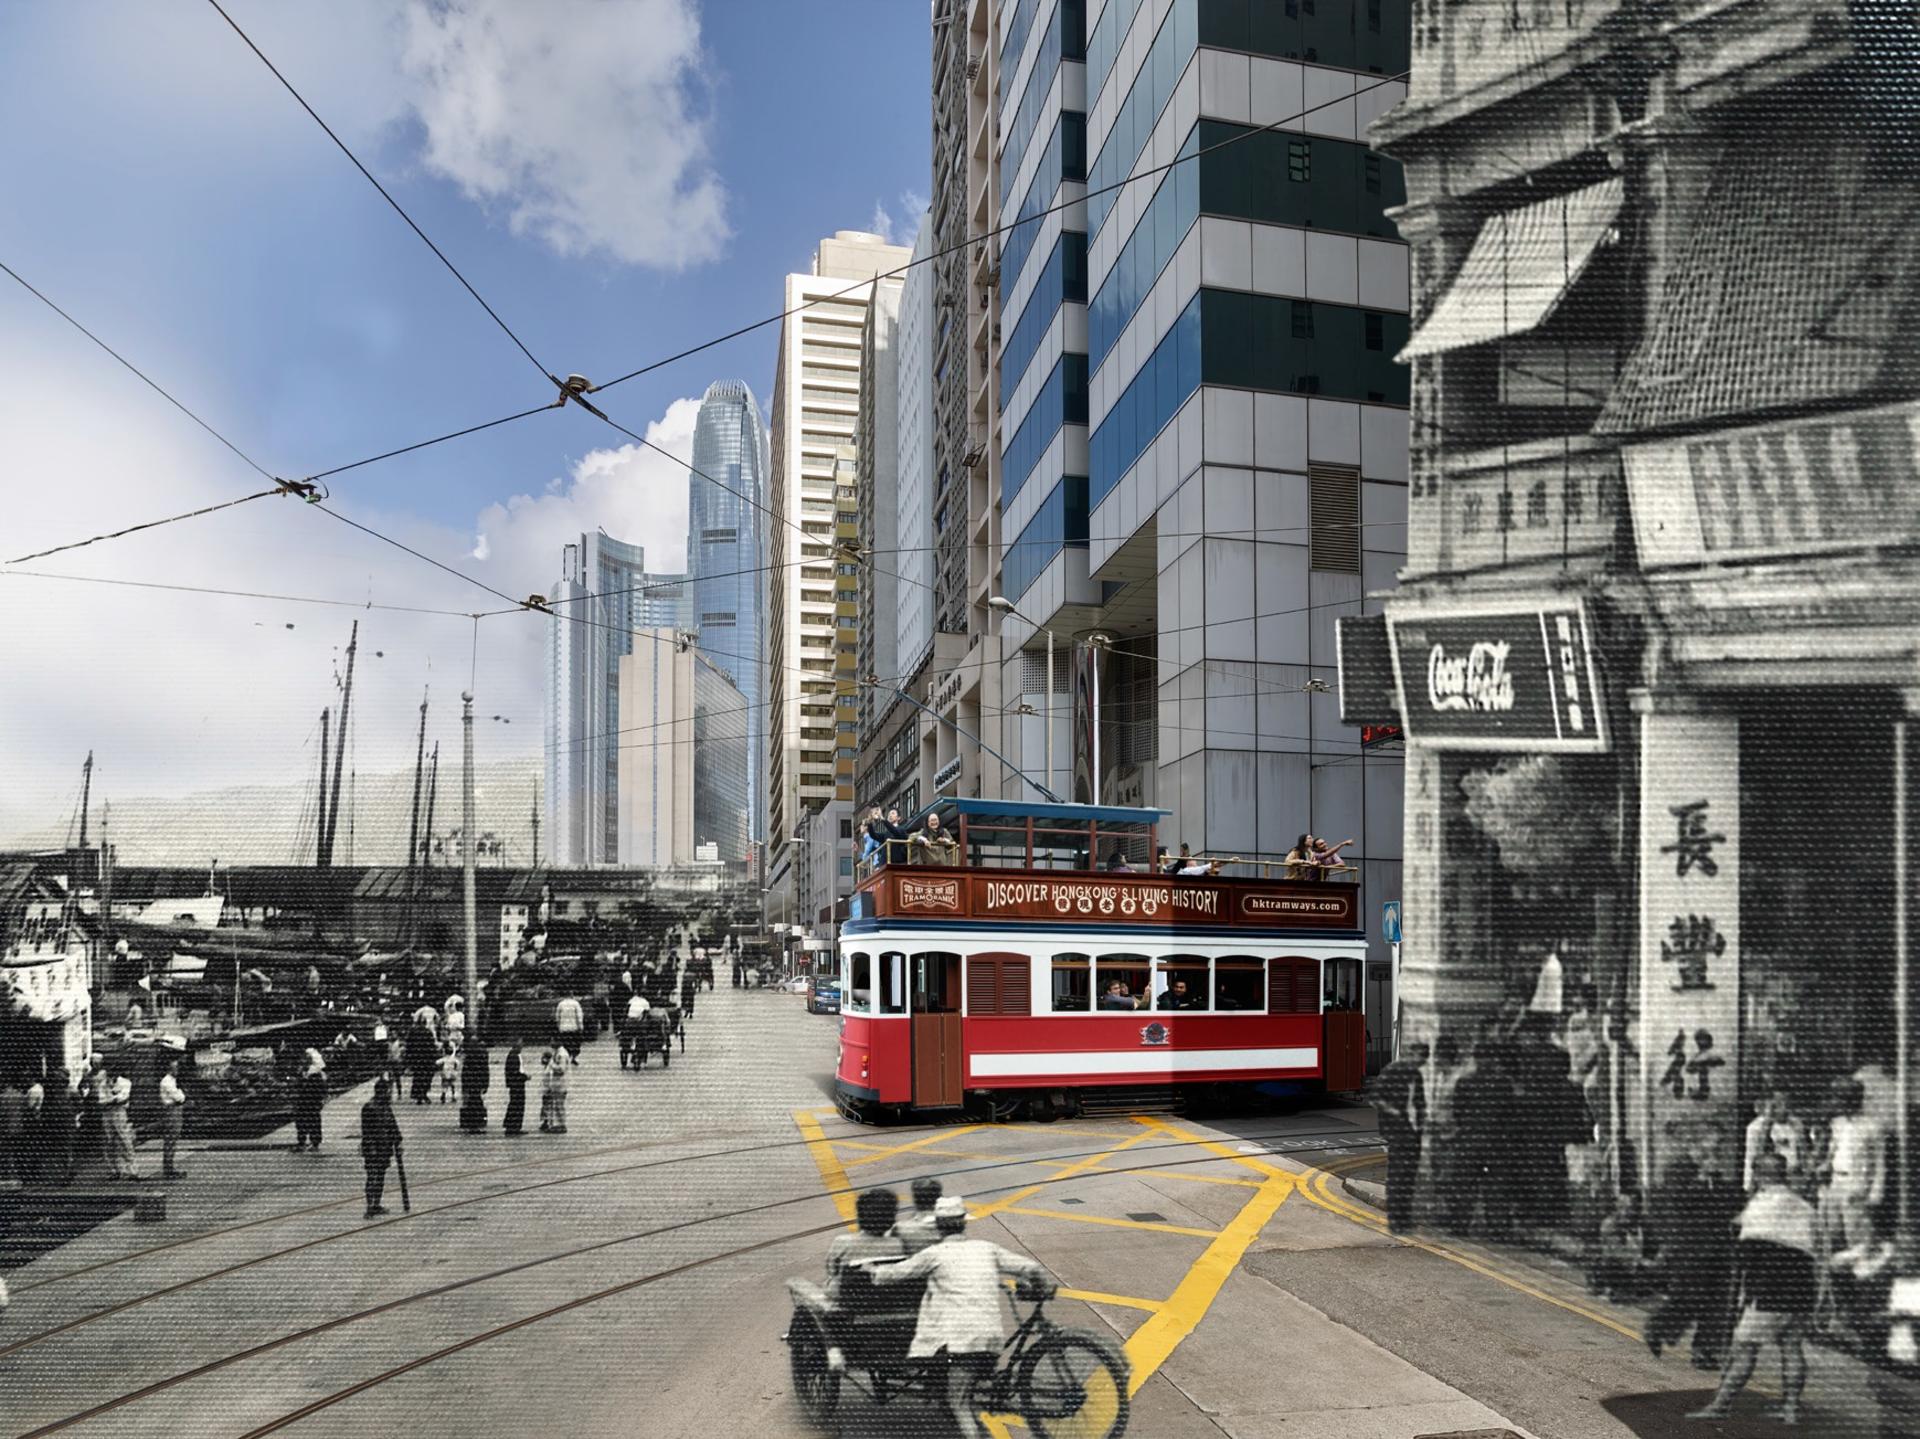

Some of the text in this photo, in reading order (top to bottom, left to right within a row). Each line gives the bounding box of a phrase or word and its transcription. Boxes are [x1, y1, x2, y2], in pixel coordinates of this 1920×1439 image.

[987, 882, 1048, 909] DISCOVER
[1131, 887, 1169, 904] LIVING
[1171, 889, 1219, 915] HISTORY
[1252, 899, 1340, 912] hktramways.com
